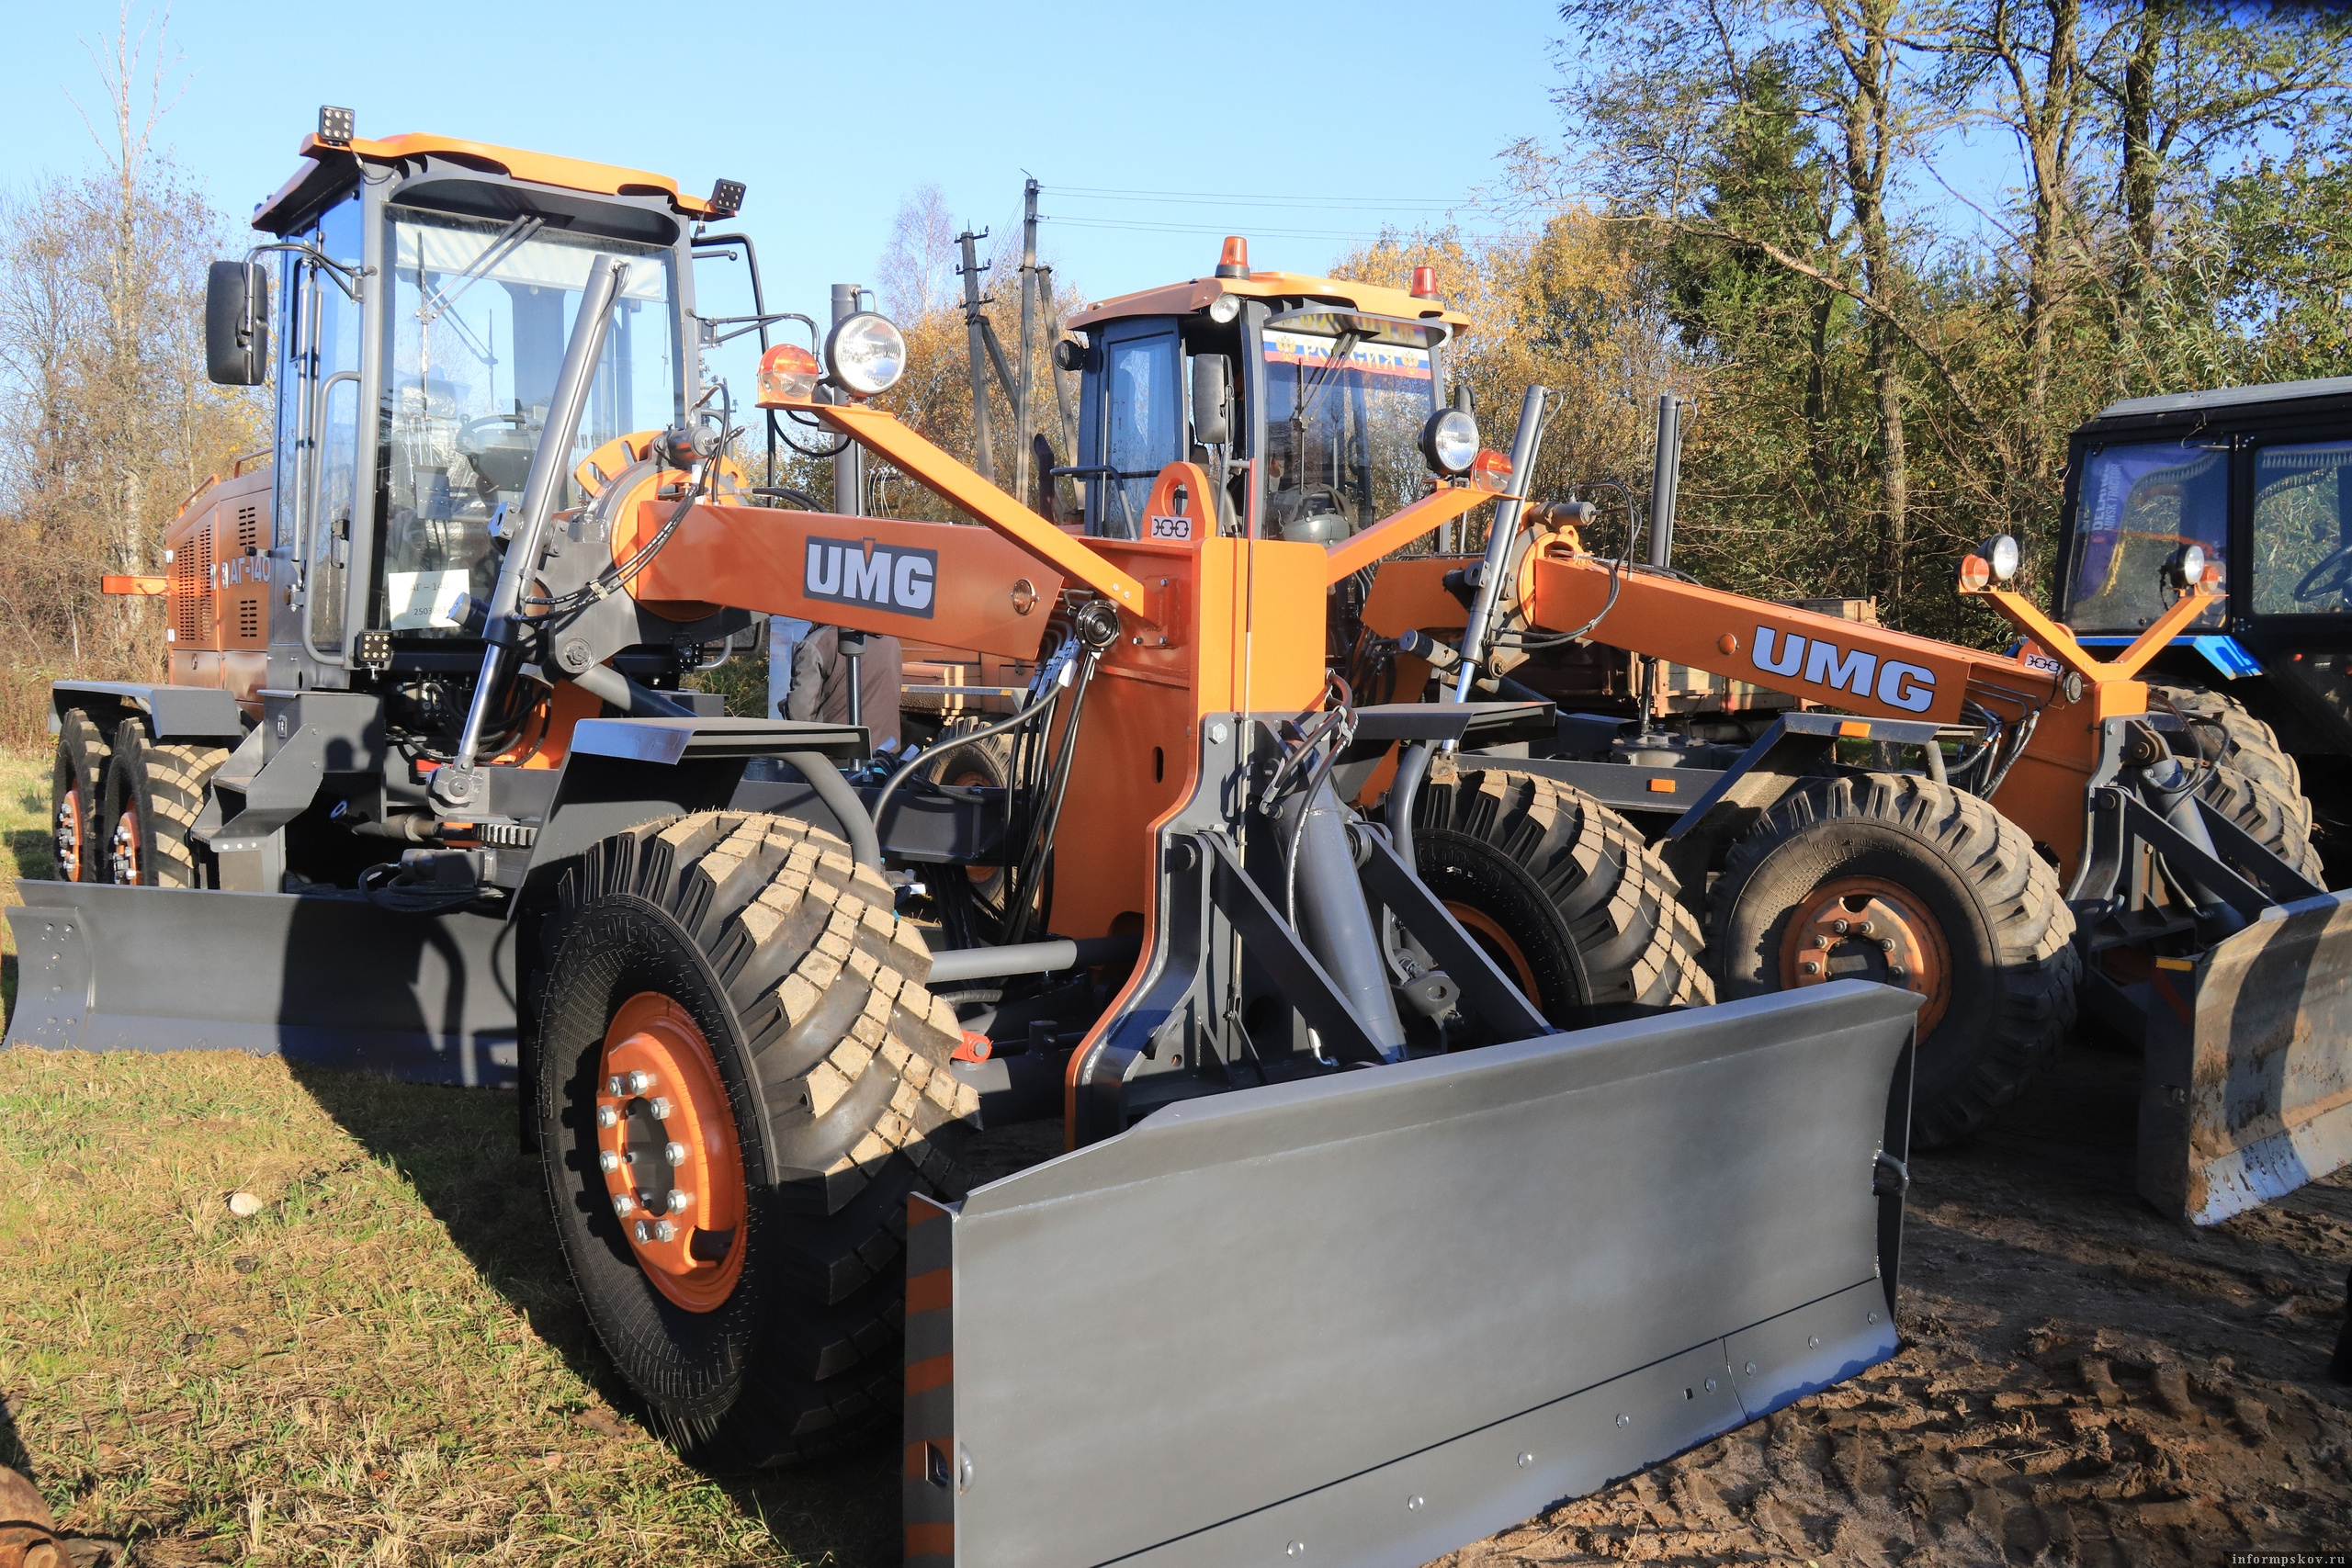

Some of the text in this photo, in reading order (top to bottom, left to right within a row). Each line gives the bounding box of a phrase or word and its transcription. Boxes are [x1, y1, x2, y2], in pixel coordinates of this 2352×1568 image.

[2104, 463, 2121, 531] MINSK TRACTOR
[230, 555, 271, 585] АГ-140
[807, 543, 933, 610] UMG
[1751, 625, 1937, 714] UMG
